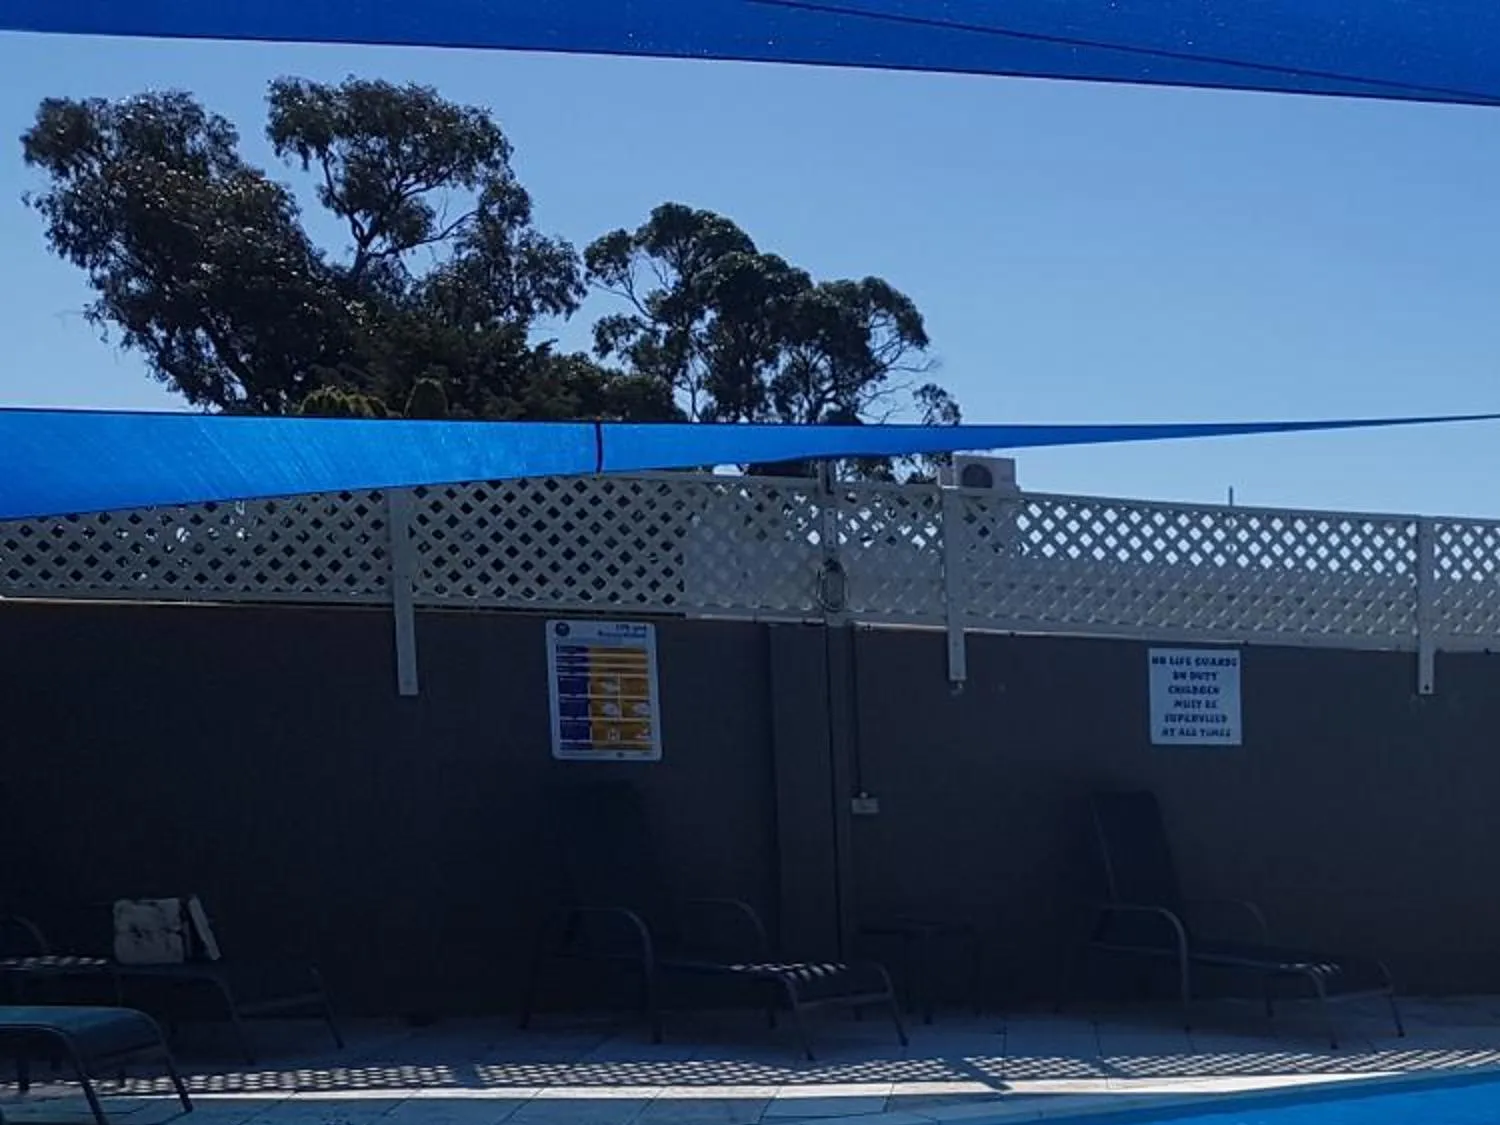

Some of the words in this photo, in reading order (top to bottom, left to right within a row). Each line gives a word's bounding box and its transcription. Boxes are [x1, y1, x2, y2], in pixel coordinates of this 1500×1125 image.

[1169, 656, 1192, 666] LIFE
[1195, 657, 1237, 667] GUARDS
[1189, 671, 1217, 681] DUTY
[1168, 685, 1220, 695] CHILDREN
[1173, 699, 1202, 709] MUST
[1164, 713, 1228, 723] SUPERVISED
[1161, 727, 1176, 737] AT
[1178, 727, 1197, 737] ALL
[1199, 727, 1231, 737] TIMES
